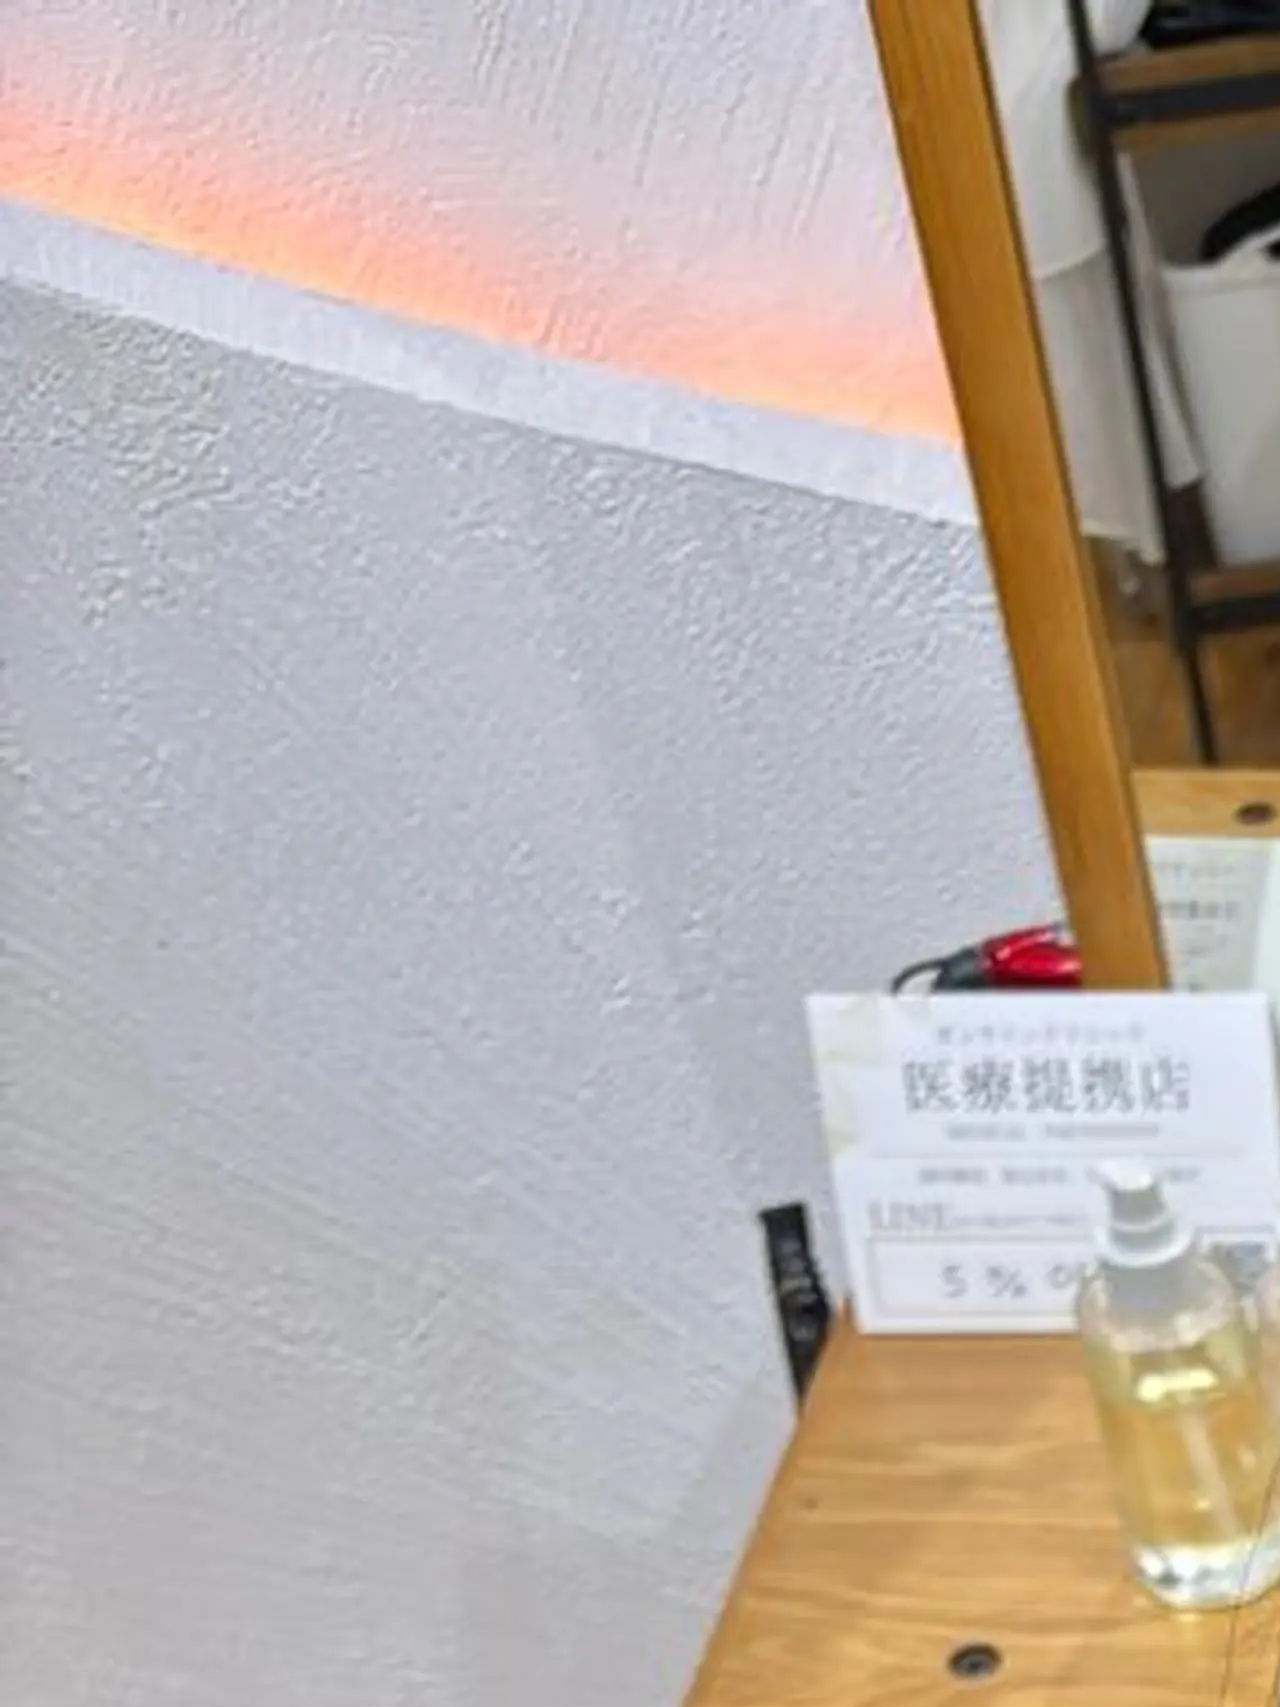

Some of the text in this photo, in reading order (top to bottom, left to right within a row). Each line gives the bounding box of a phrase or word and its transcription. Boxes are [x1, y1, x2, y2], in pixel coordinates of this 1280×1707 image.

[903, 1054, 1190, 1116] 医療提携店
